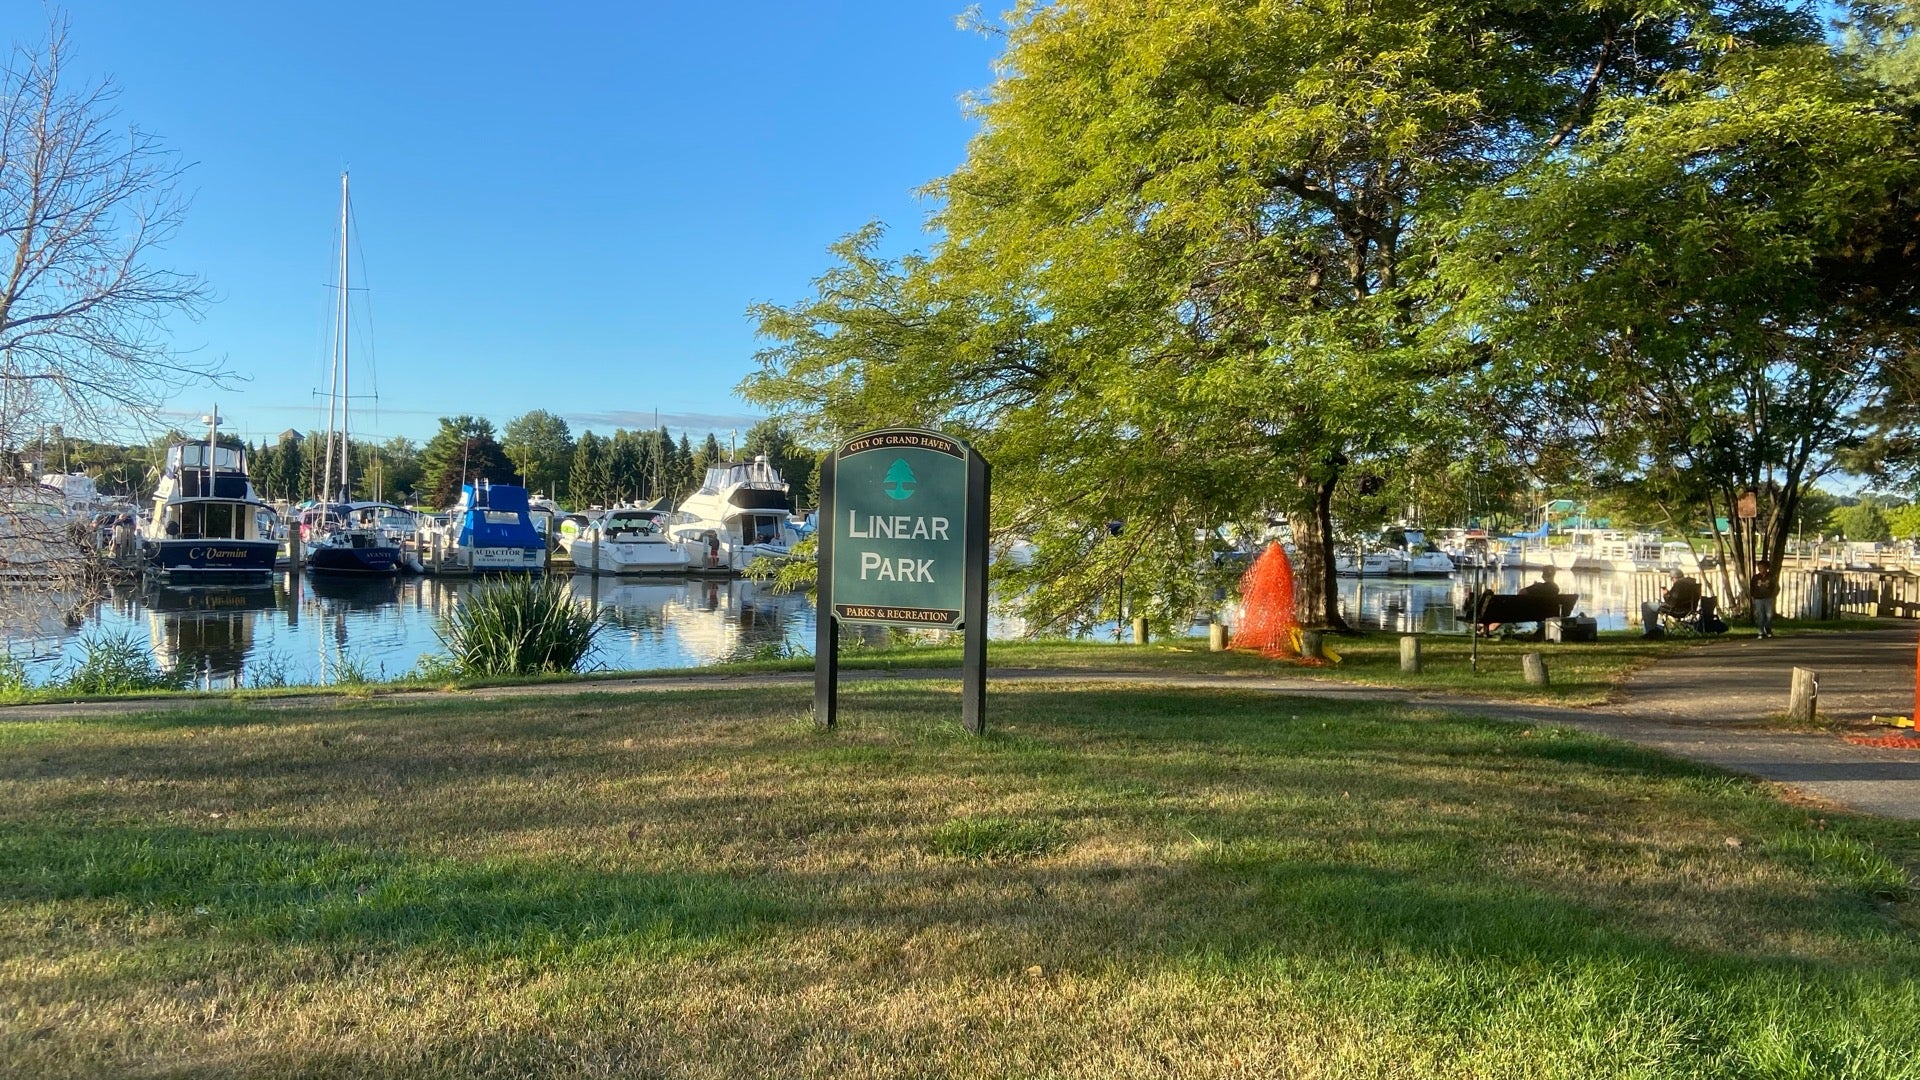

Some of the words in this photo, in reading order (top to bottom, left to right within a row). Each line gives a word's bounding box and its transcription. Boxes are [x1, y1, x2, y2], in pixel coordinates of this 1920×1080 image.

[850, 440, 870, 451] CITY
[872, 437, 884, 446] OF
[886, 436, 918, 445] GRAND
[921, 438, 951, 451] HAVEN
[848, 510, 950, 540] LINEAR
[861, 552, 935, 583] PARK
[846, 608, 875, 617] PARKS
[877, 610, 885, 618] &
[887, 610, 948, 621] RECREATION
